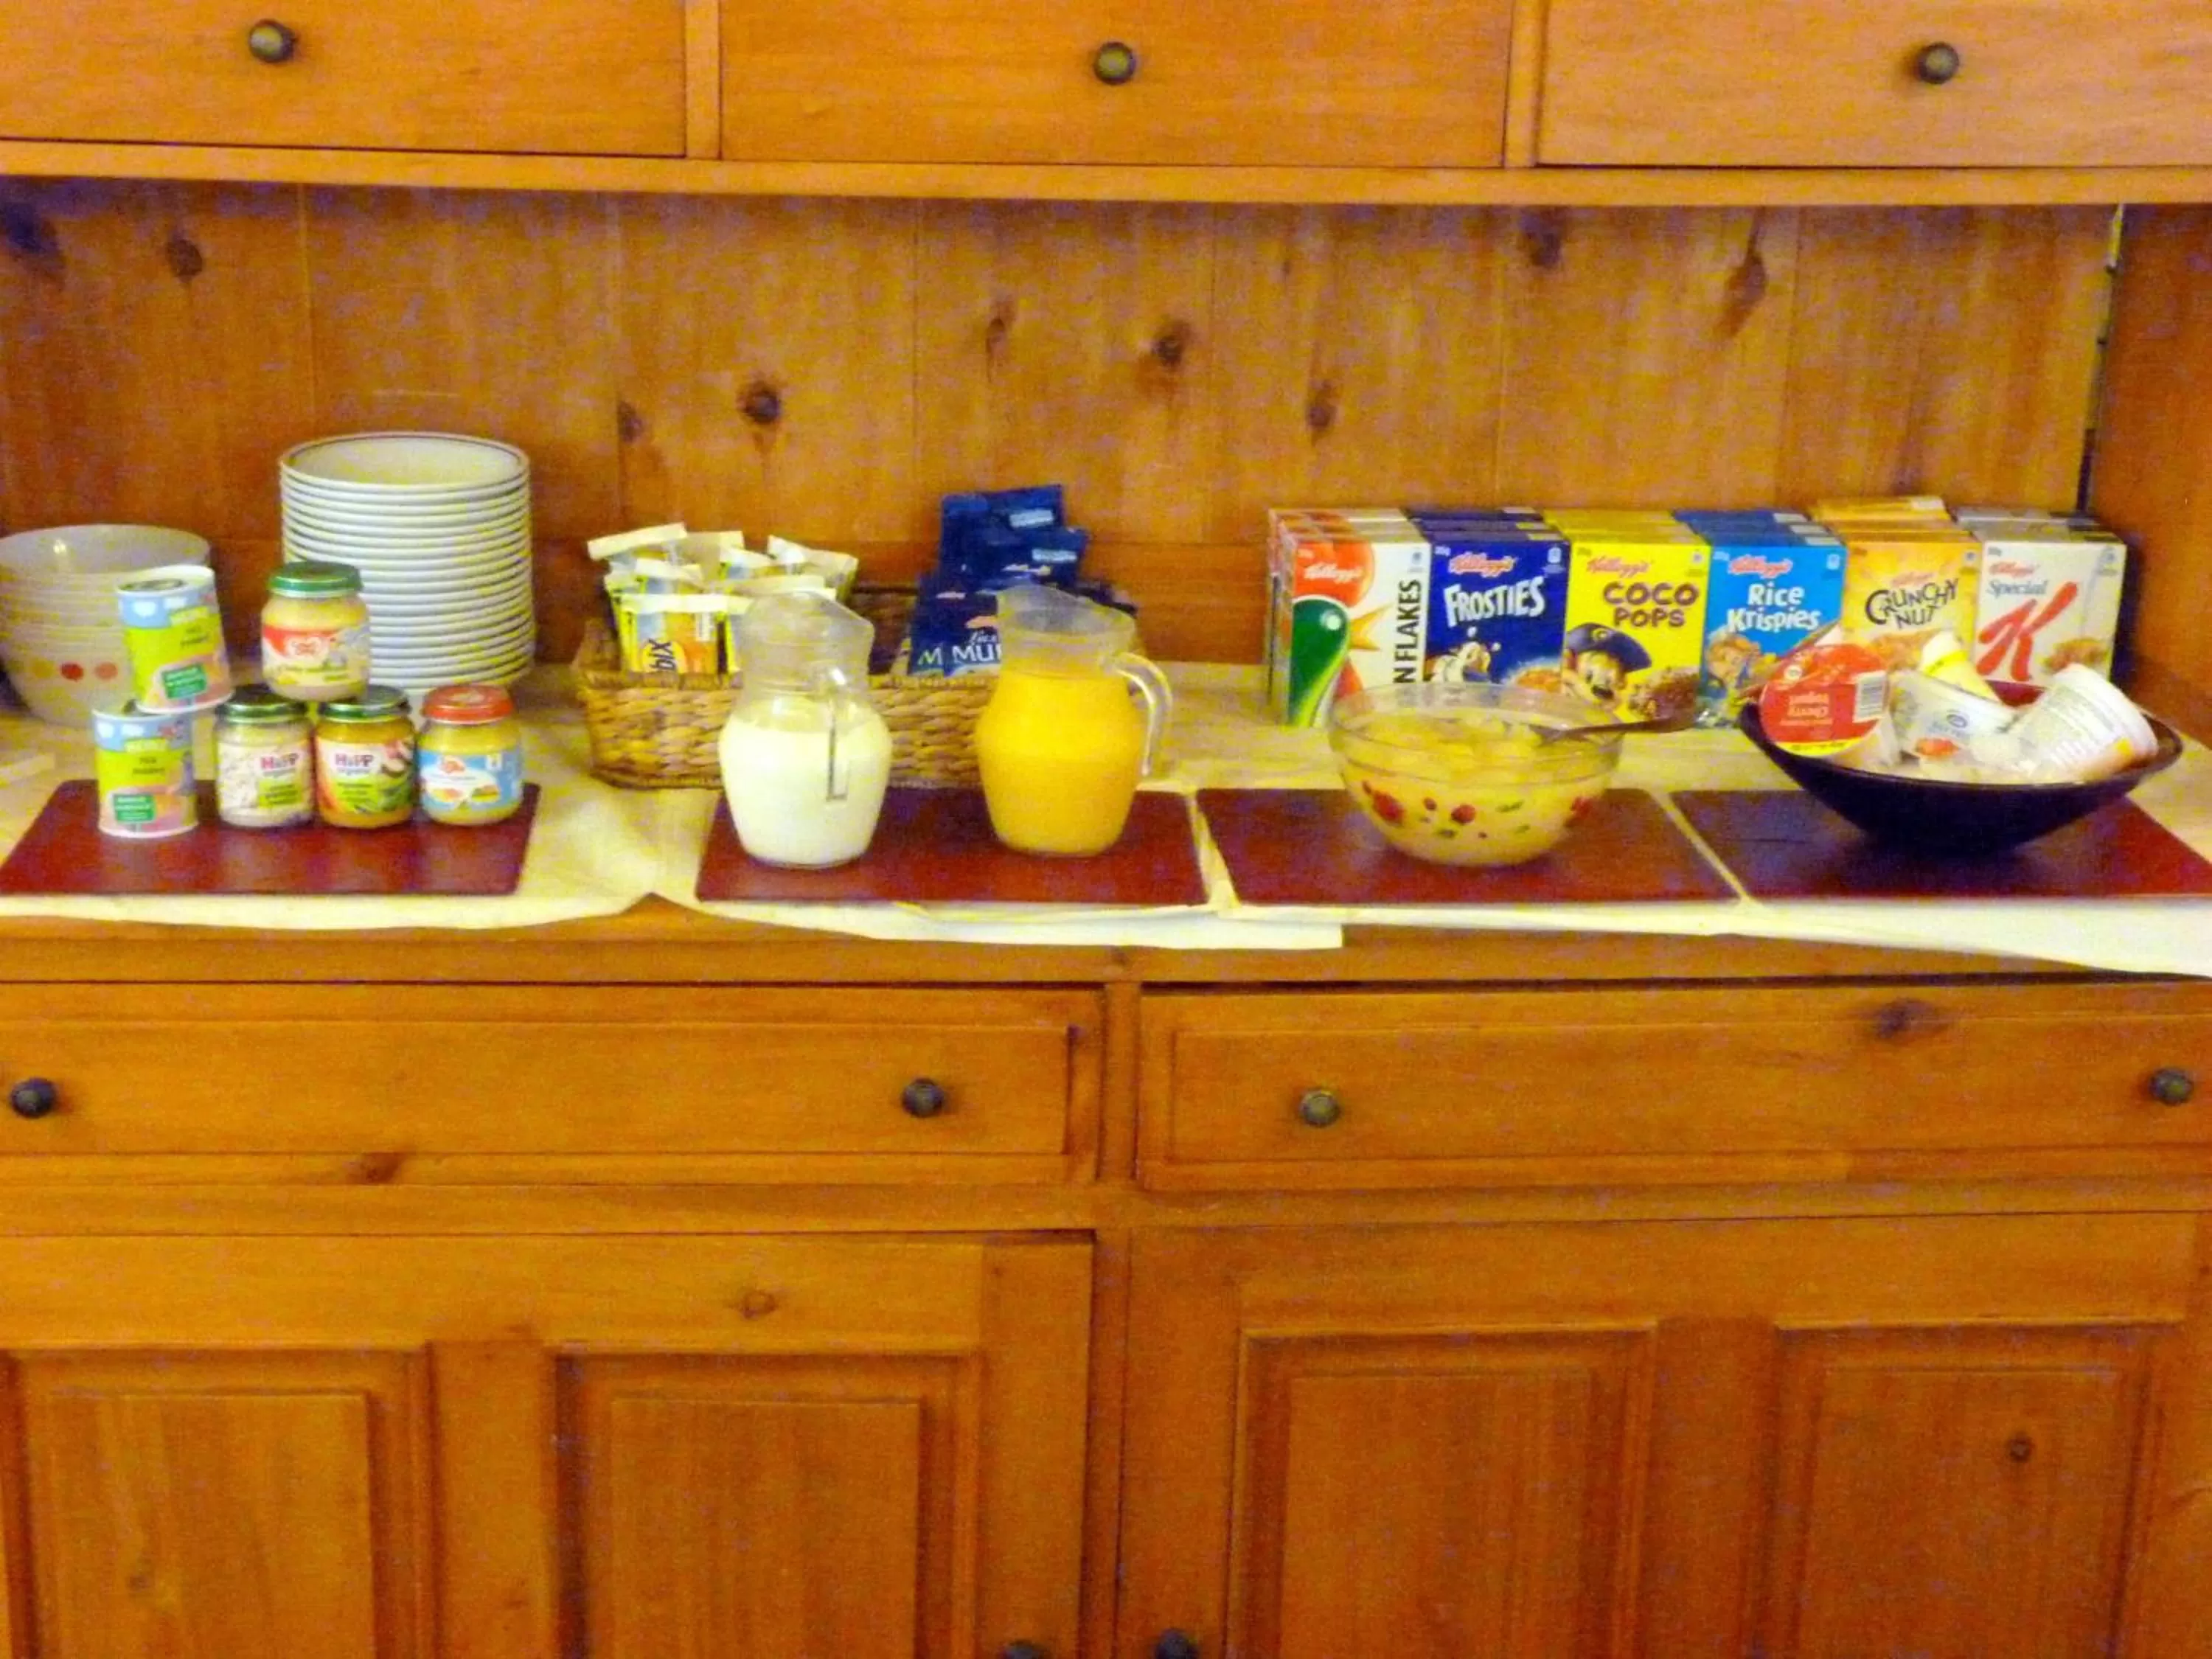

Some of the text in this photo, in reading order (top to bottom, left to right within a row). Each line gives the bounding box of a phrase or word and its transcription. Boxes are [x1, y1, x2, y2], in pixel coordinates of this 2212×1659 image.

[1443, 575, 1545, 628] FROSTIES
[1603, 581, 1700, 606] COCO
[1747, 581, 1806, 607] Rice
[1865, 577, 1960, 625] CRUNCHY
[1987, 579, 2049, 599] Special
[1394, 579, 1422, 662] FLAKES
[1613, 606, 1686, 627] POPS
[1727, 606, 1823, 633] Krispies
[1895, 604, 1941, 629] NUT
